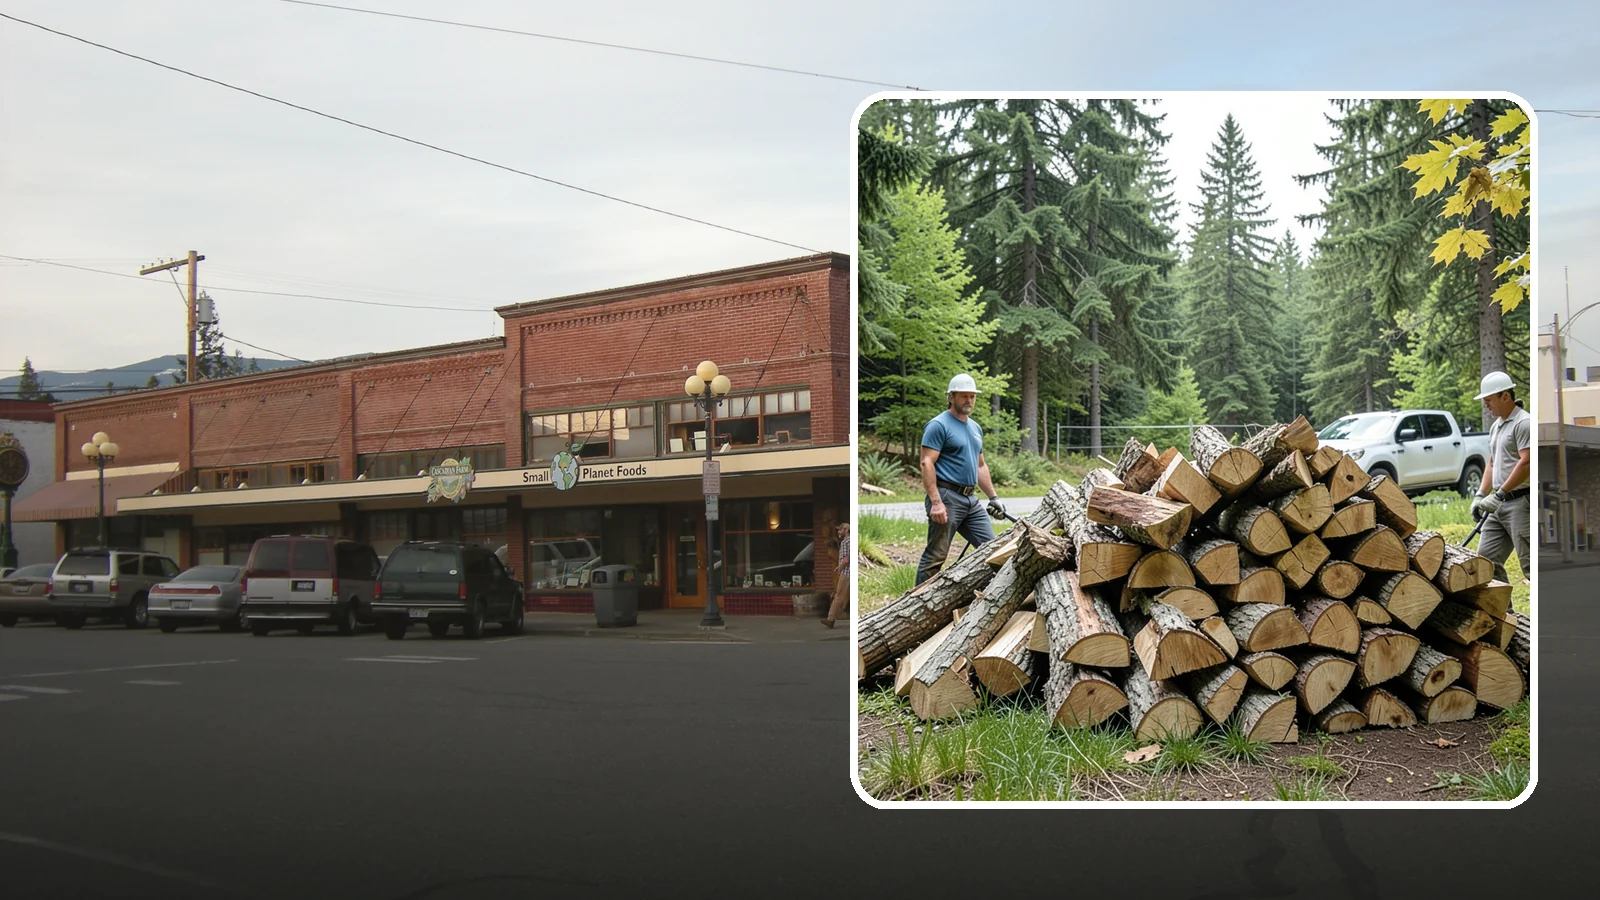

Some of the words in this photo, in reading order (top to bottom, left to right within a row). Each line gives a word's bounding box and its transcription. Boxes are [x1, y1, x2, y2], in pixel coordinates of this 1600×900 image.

[523, 471, 549, 483] Small
[583, 468, 614, 479] Planet
[617, 464, 647, 477] Foods
